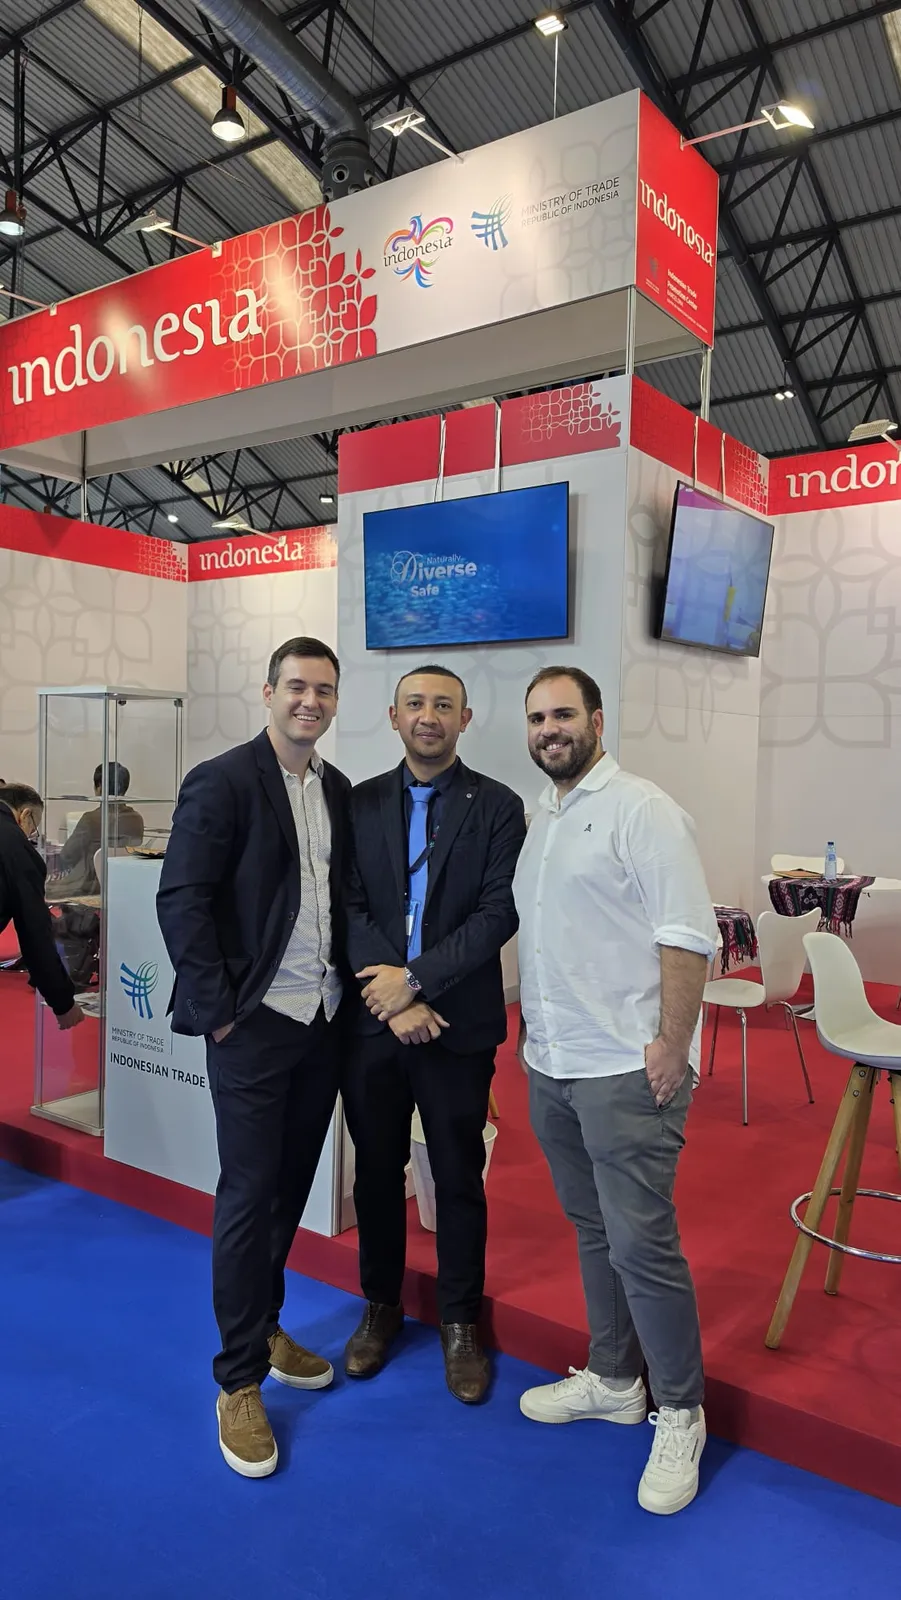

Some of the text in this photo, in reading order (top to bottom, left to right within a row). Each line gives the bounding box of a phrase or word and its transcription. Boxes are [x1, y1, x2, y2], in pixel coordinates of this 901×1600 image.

[521, 177, 620, 217] MINISTRY OF TRADE
[521, 190, 619, 227] REPUBLIC OF INDONESIA
[640, 179, 715, 267] indonesia
[383, 236, 453, 267] indonesia
[8, 288, 267, 406] indonesia
[199, 542, 305, 571] indonesia
[426, 553, 462, 565] Naturally
[411, 583, 440, 598] Safe
[111, 1026, 164, 1047] MINISTRY OF TRADE
[111, 1035, 133, 1047] REPUBLIC
[139, 1042, 164, 1053] INDONESIA
[110, 1052, 206, 1088] INDONESIAN TRADE
